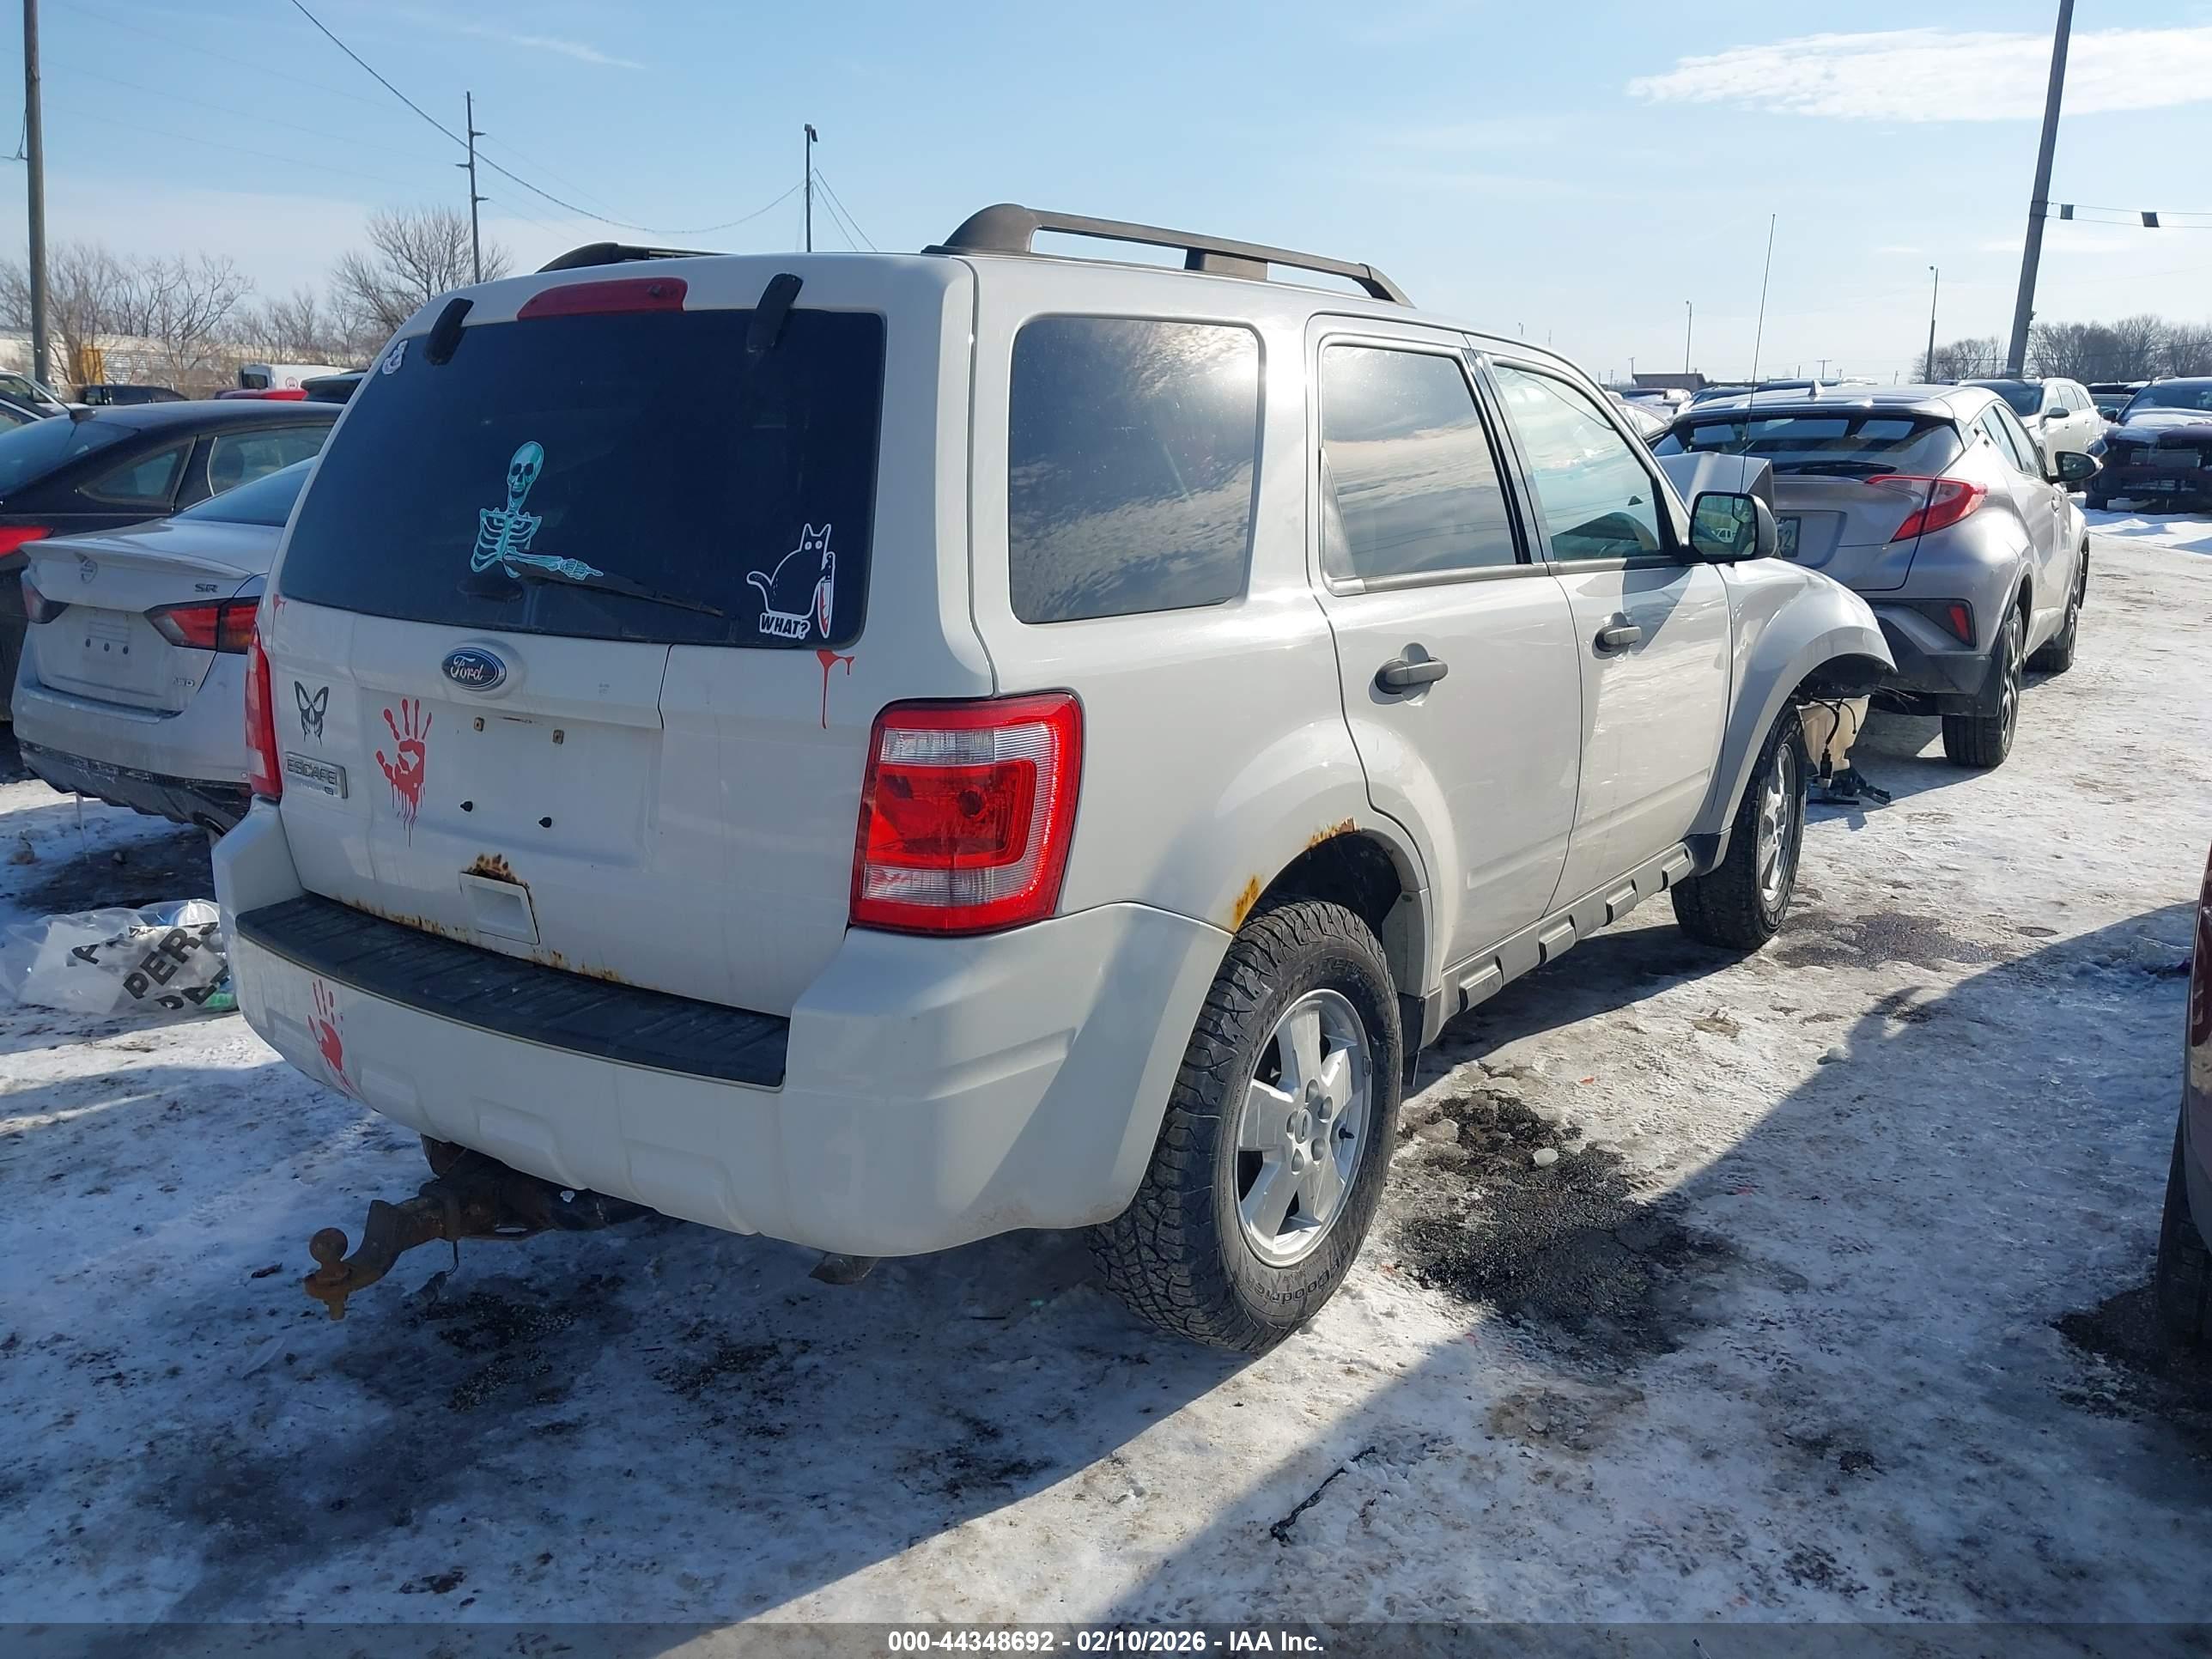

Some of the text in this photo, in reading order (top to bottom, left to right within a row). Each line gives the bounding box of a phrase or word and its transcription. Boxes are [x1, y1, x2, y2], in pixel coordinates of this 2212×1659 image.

[194, 583, 218, 593] SR
[760, 614, 810, 638] WHAT?
[450, 655, 484, 681] Ford
[287, 758, 337, 786] ESCAPE
